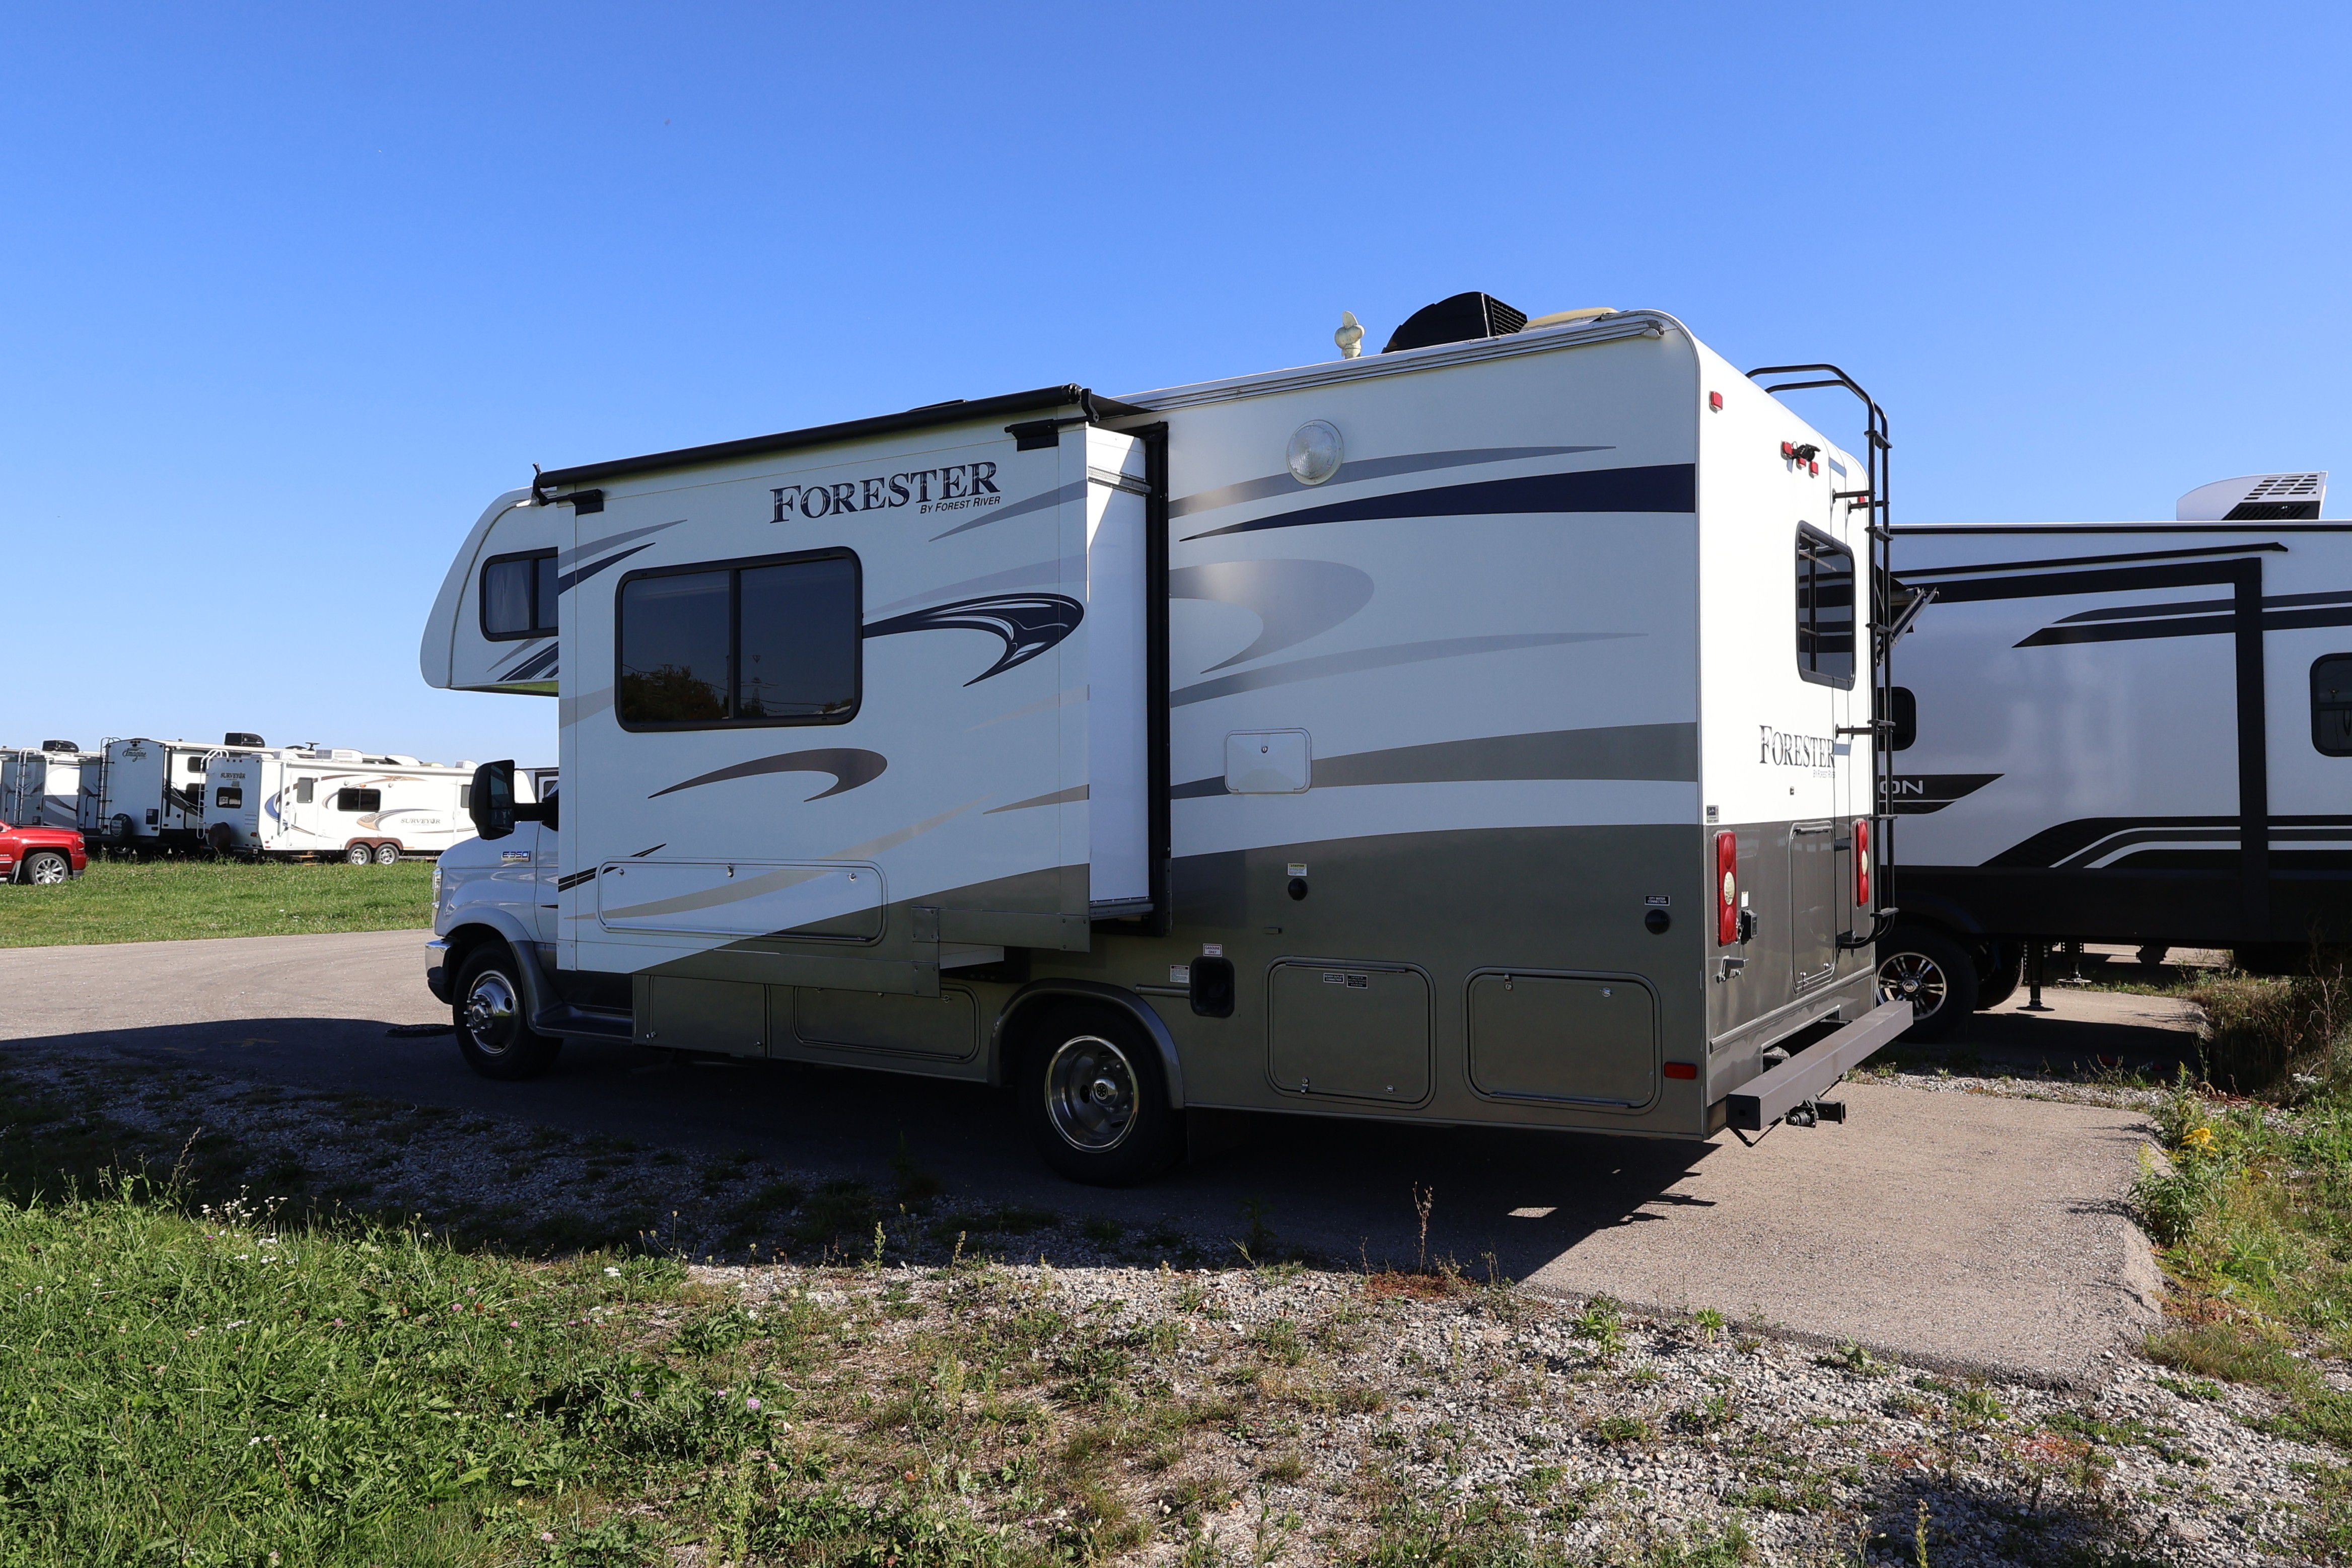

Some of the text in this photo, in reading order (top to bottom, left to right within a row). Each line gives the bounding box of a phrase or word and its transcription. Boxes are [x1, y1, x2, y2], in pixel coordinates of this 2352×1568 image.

[770, 461, 1001, 524] FORESTER
[920, 496, 1001, 514] BY FOREST RIVER
[1759, 725, 1835, 768] FORESTER
